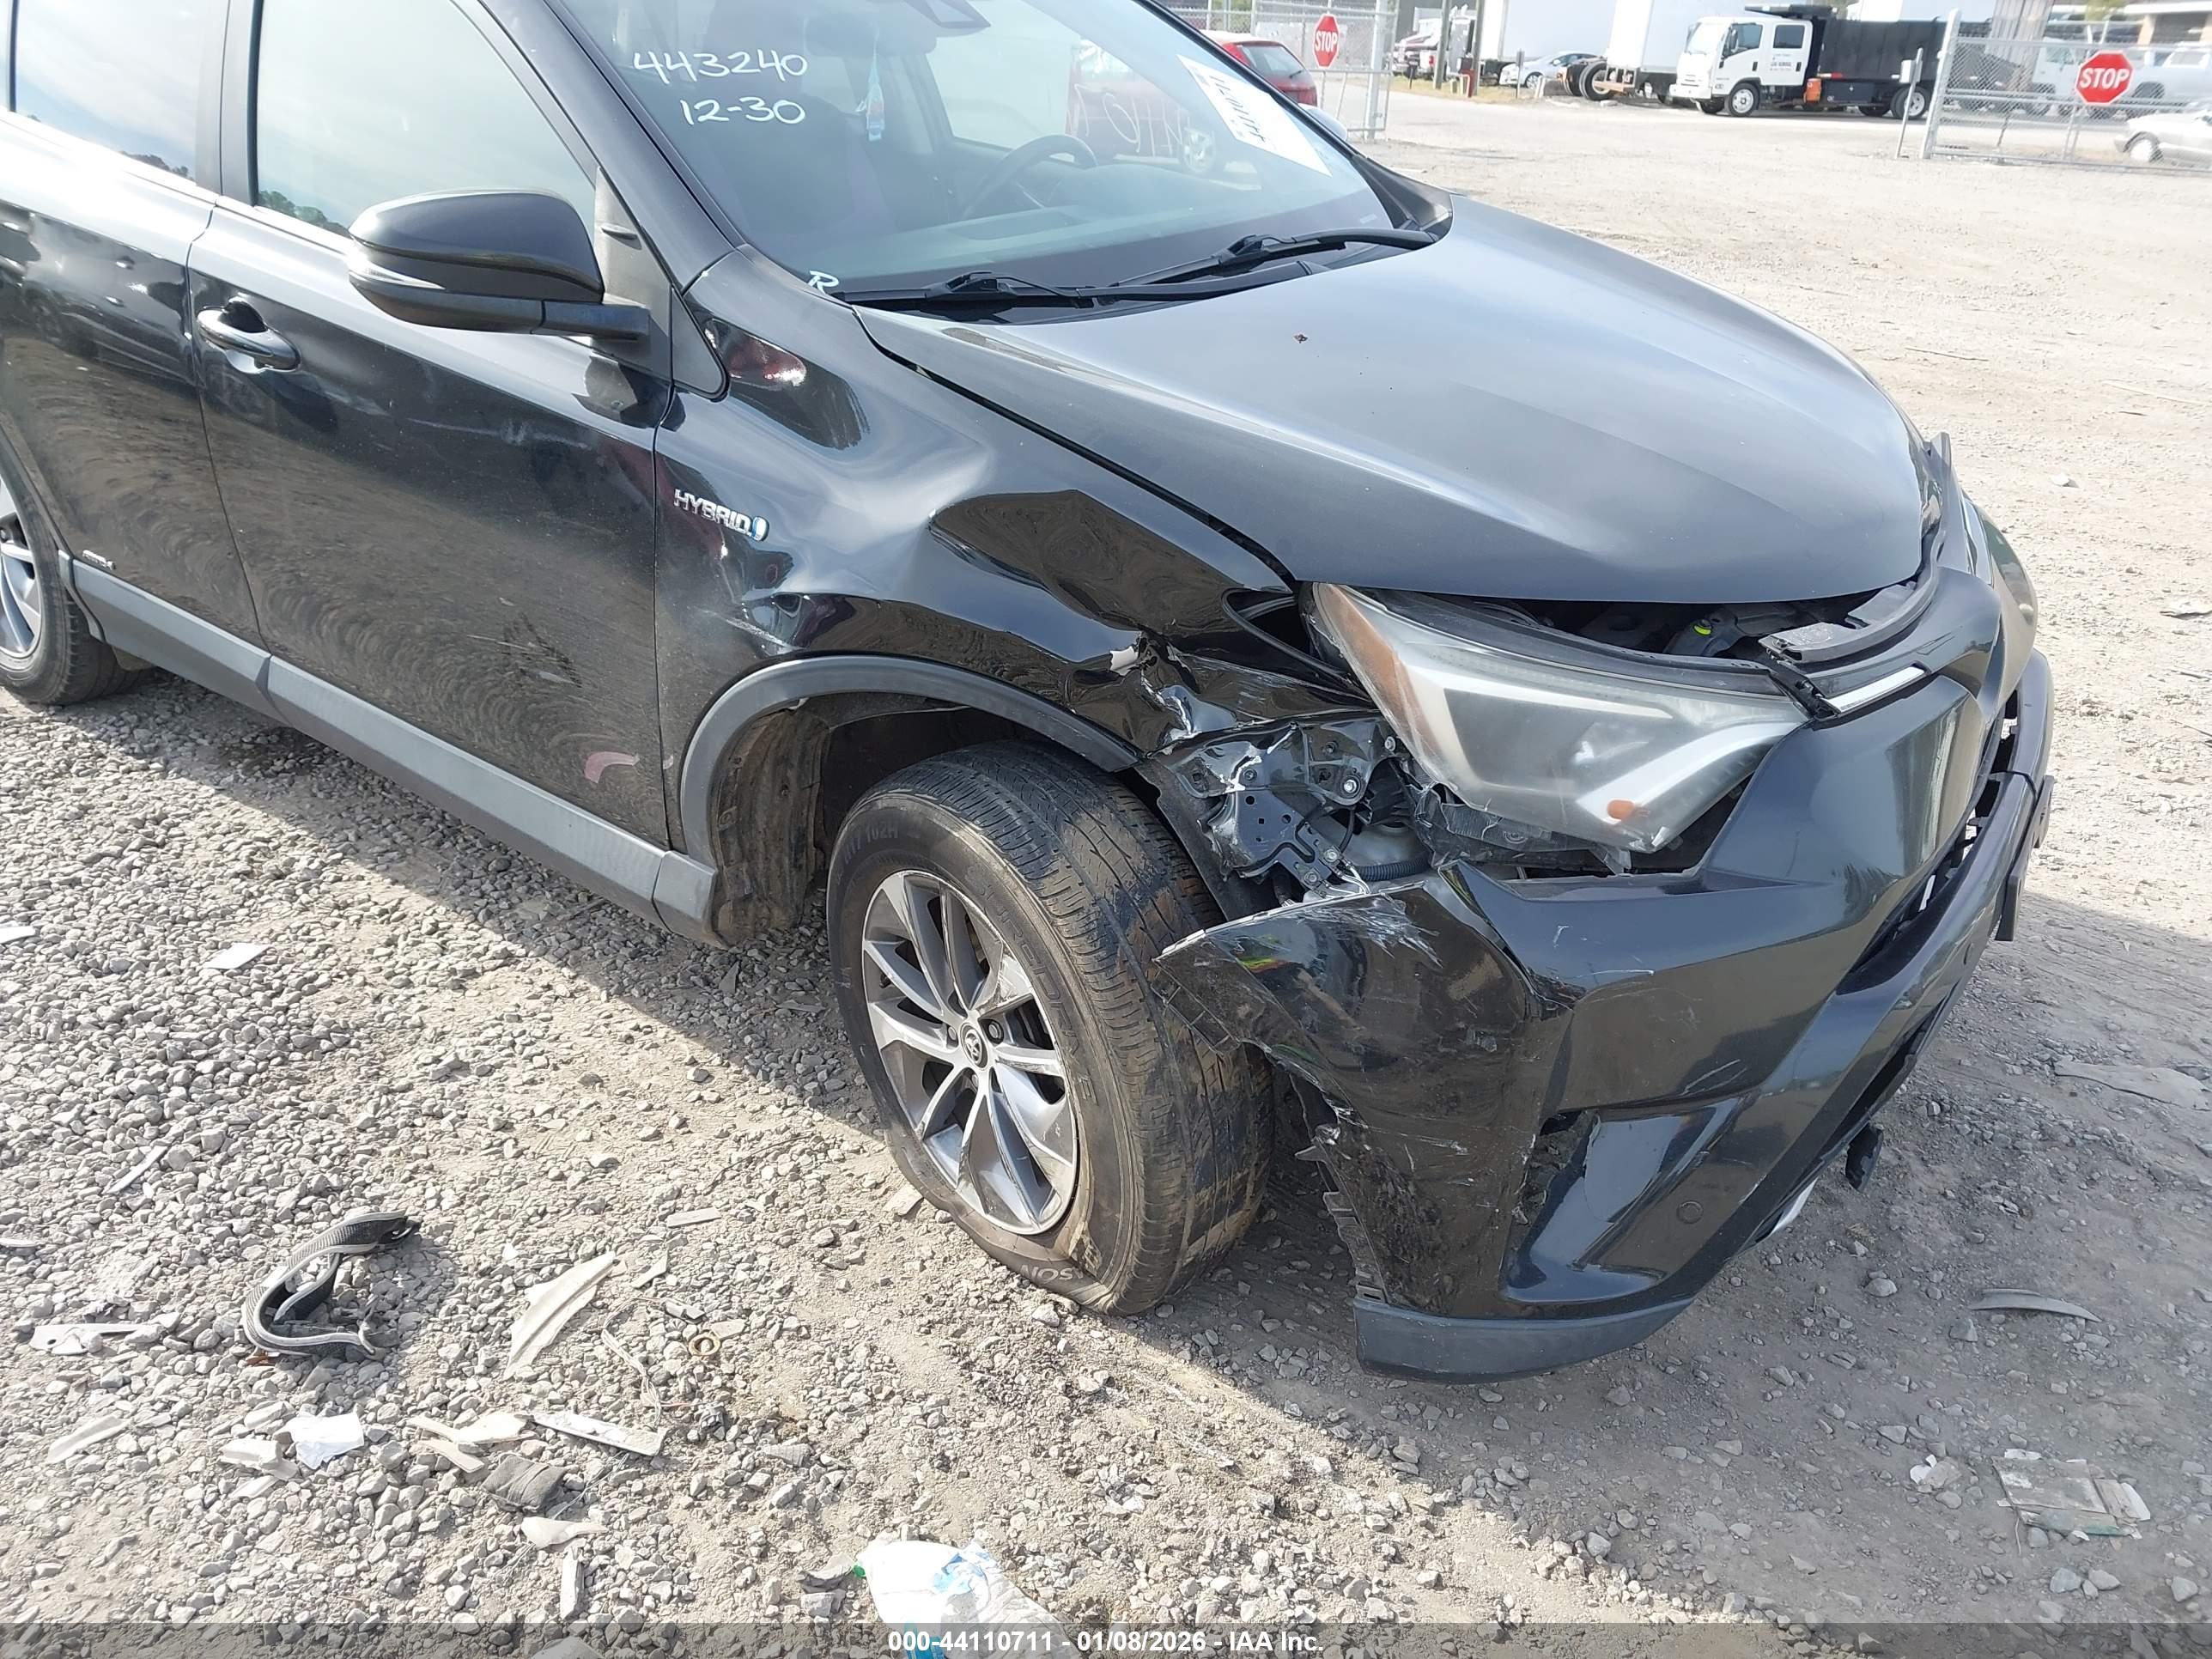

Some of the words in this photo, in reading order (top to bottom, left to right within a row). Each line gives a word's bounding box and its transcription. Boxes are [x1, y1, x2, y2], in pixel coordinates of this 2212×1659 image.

[1315, 30, 1339, 52] STOP
[633, 49, 808, 84] 443240
[2079, 68, 2130, 89] STOP
[680, 96, 806, 125] 12-30
[808, 270, 839, 295] R
[673, 489, 752, 536] HYBRID
